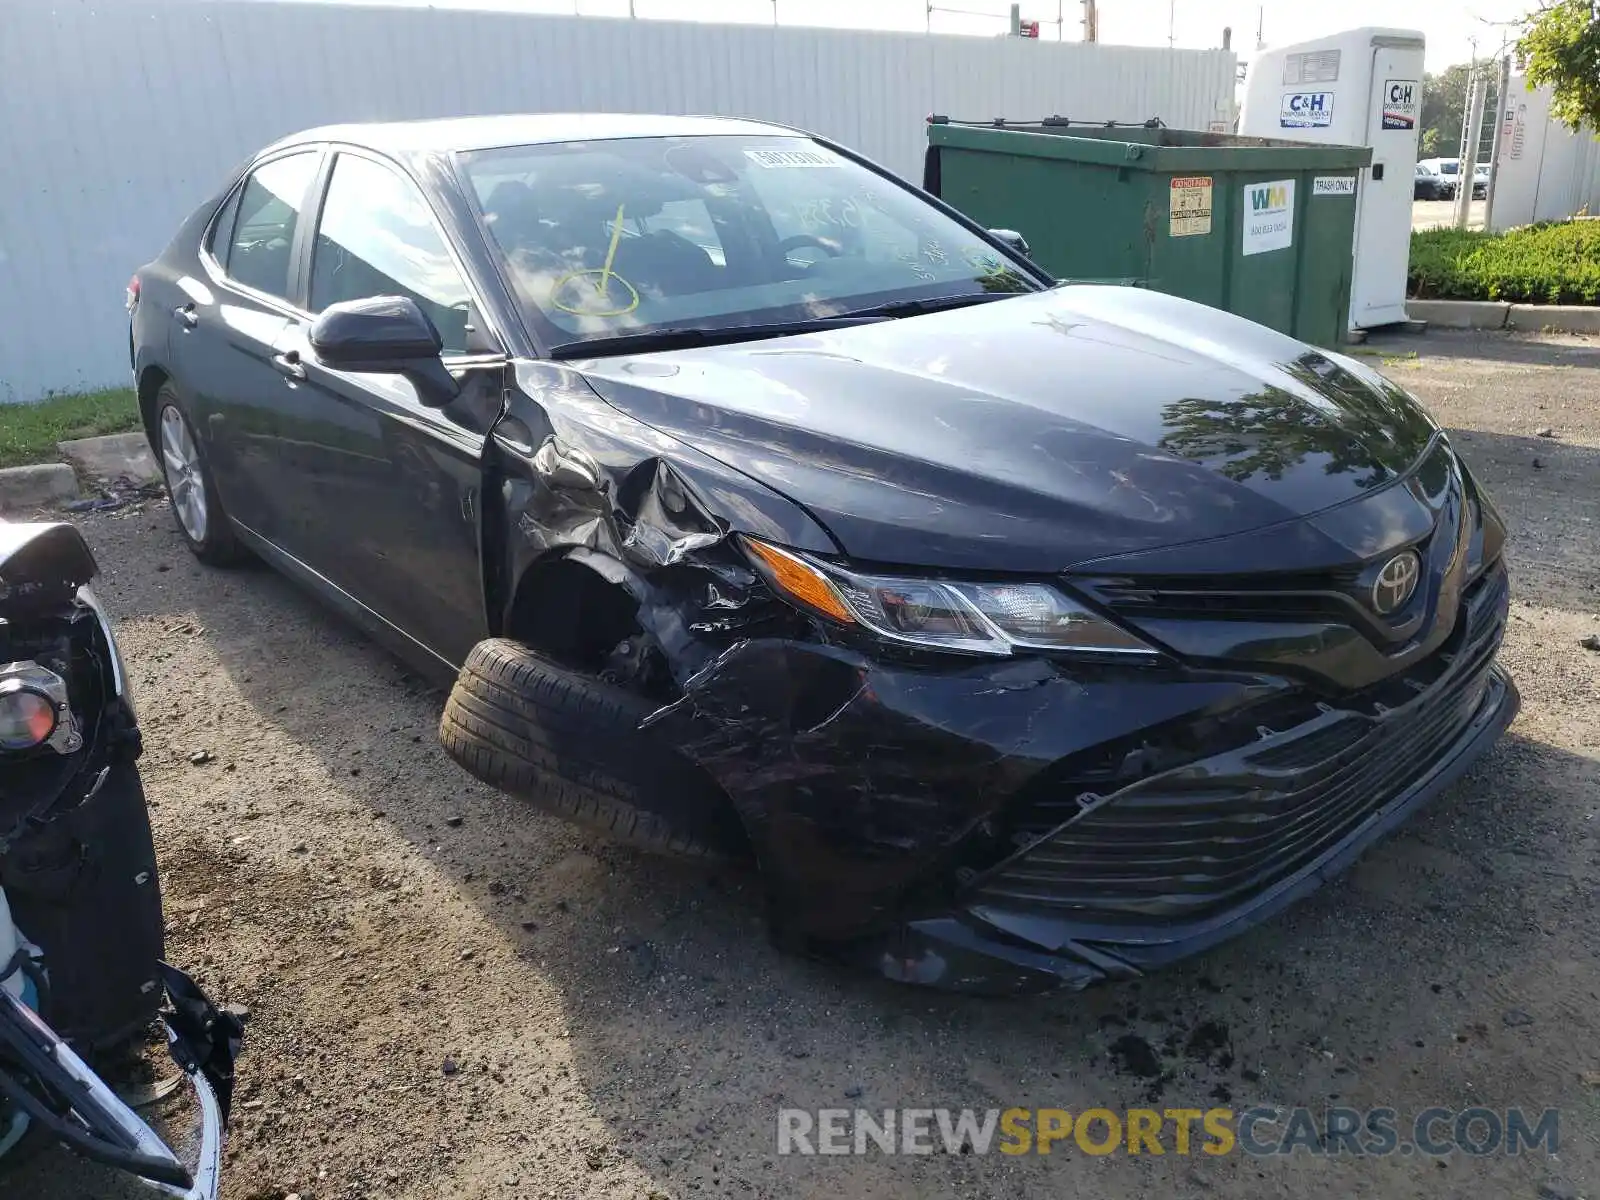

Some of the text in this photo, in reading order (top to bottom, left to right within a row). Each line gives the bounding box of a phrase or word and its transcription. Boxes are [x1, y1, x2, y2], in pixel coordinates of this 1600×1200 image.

[1391, 85, 1412, 103] C&H
[1290, 95, 1324, 110] C&H
[1315, 180, 1354, 190] TRASH ONLY
[1252, 187, 1287, 209] WM
